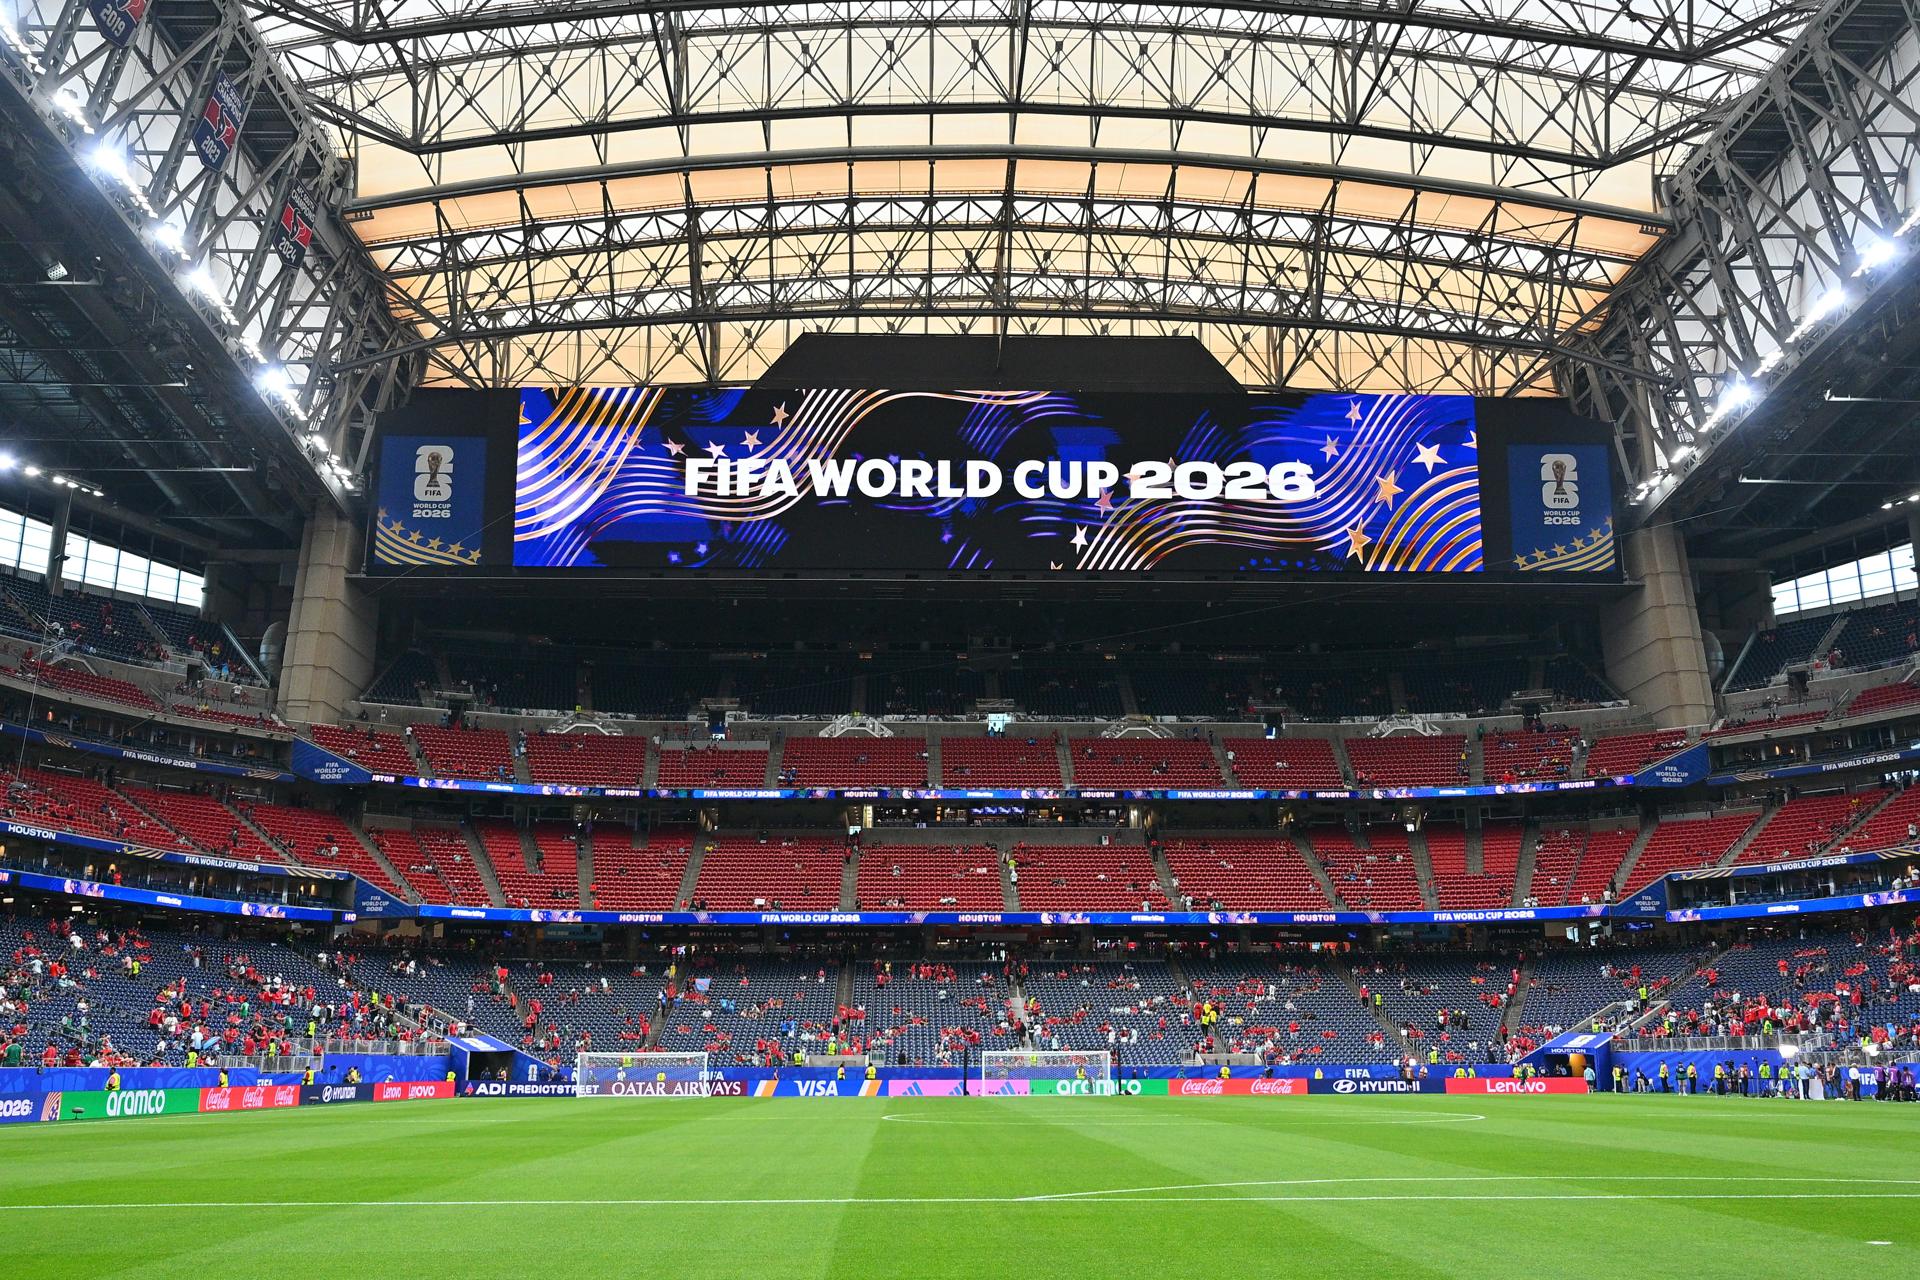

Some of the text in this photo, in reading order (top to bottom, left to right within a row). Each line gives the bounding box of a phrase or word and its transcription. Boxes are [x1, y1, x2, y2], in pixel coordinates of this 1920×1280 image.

[100, 3, 126, 37] 2019
[201, 136, 220, 163] 2023
[278, 236, 296, 263] 2024
[685, 458, 1316, 500] FIFA WORLD CUP 2026
[412, 510, 451, 518] 2026
[1544, 517, 1580, 525] 2026
[122, 750, 136, 759] FIFA
[137, 752, 159, 763] WORLD
[172, 759, 196, 768] 2026
[1838, 760, 1862, 769] WORLD
[1876, 753, 1900, 762] 2026
[1559, 780, 1595, 789] HOUSTON
[605, 789, 640, 797] HOUSTON
[8, 824, 56, 840] HOUSTON
[185, 856, 200, 864] FIFA
[200, 858, 224, 867] WORLD
[237, 863, 259, 872] 2026
[1782, 862, 1806, 870] WORLD
[1822, 858, 1847, 866] 2026
[1453, 912, 1484, 921] WORLD
[1504, 910, 1535, 919] 2026
[1345, 1069, 1370, 1078] FIFA
[1859, 1073, 1878, 1085] IFA
[332, 1086, 356, 1099] HYUNDAI
[383, 1084, 401, 1099] Lenovo
[475, 1083, 599, 1095] ADI PREDICTSTREET
[612, 1081, 741, 1095] QATAR AIRWAYS
[794, 1080, 838, 1096] VISA
[1056, 1079, 1141, 1095] aramco
[1181, 1079, 1224, 1094] Coca-Cola
[1251, 1079, 1295, 1094] Coca-Cola
[1486, 1079, 1546, 1092] Lenovo
[106, 1090, 165, 1116] aramco
